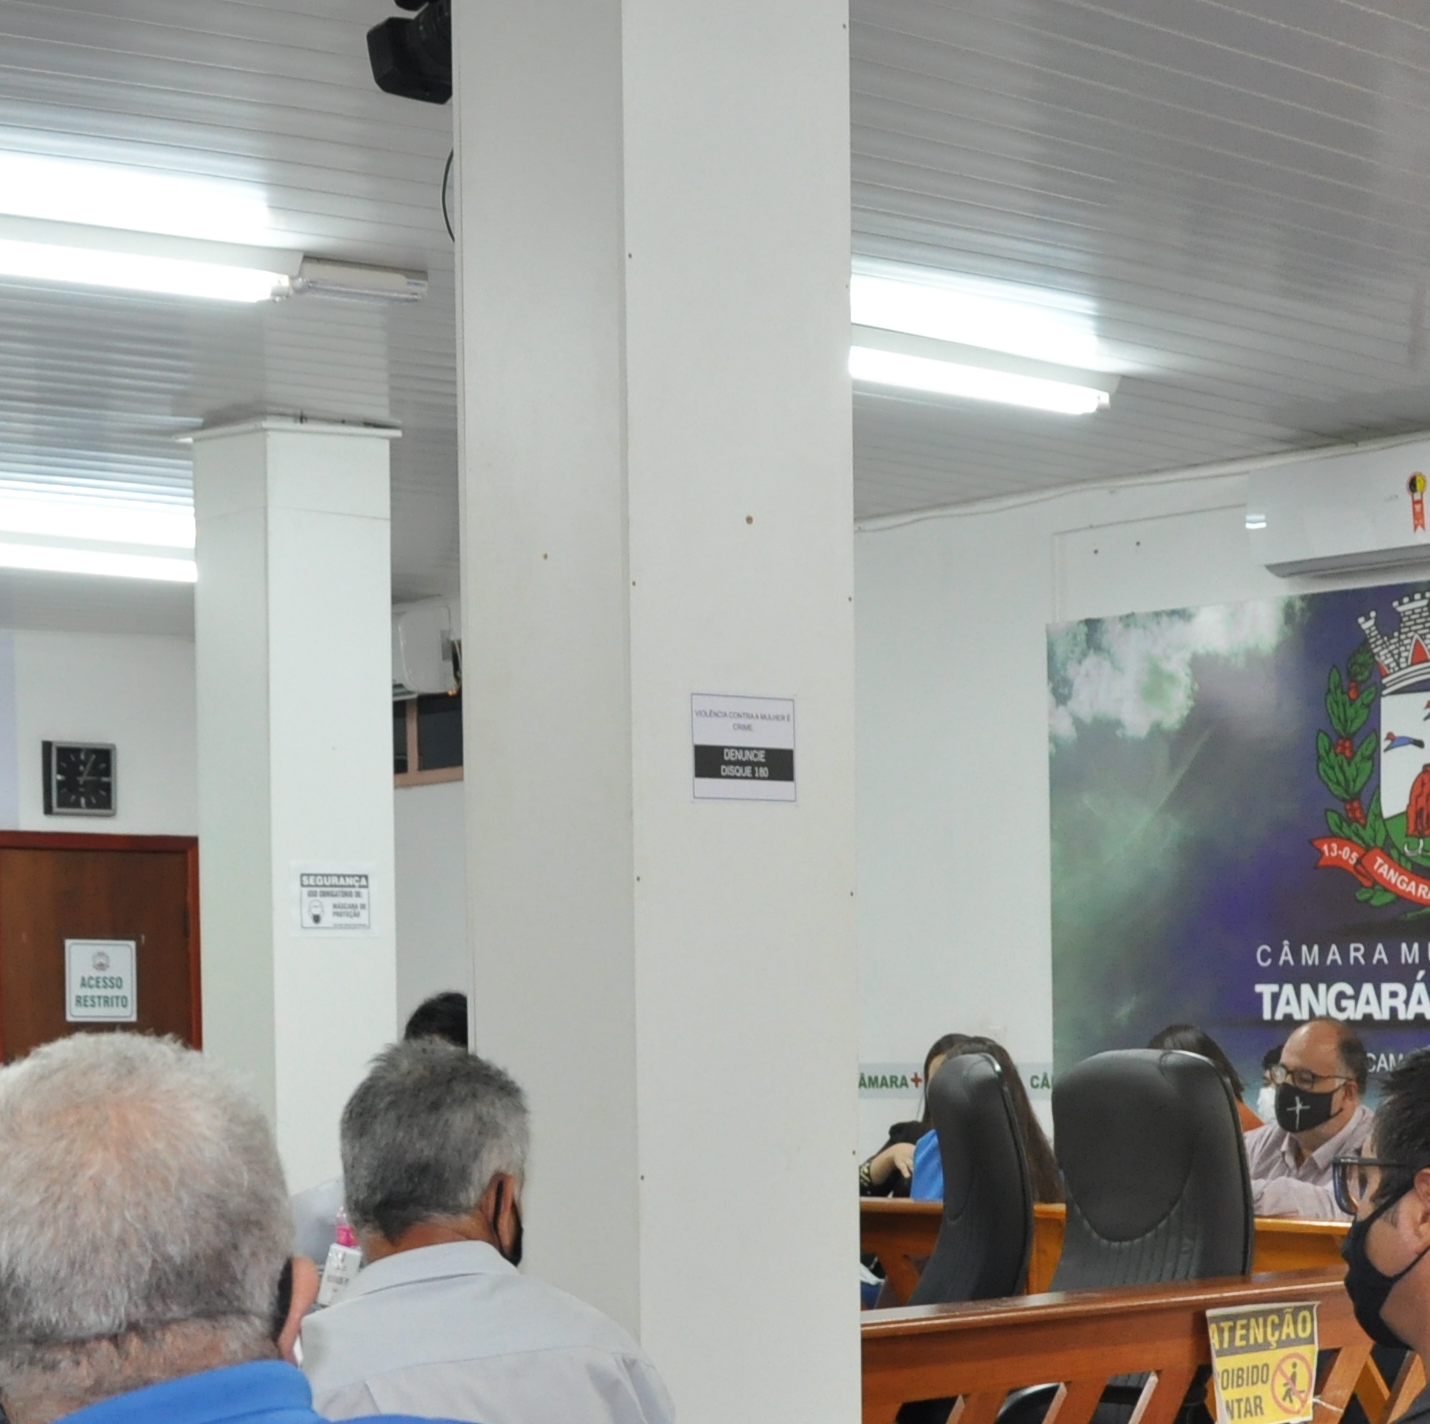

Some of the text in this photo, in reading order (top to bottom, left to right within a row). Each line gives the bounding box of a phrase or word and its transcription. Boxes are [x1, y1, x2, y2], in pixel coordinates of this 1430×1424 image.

[695, 709, 727, 718] VIOLÊNCIA
[723, 748, 766, 762] DENUNCIE
[720, 764, 769, 778] DISQUE 180
[1322, 843, 1357, 864] 13-05
[301, 875, 368, 888] SEGURANÇA
[1256, 940, 1389, 967] CÂMARA
[80, 975, 124, 990] ACESSO
[75, 994, 128, 1009] RESTRITO
[1210, 1307, 1312, 1350] ATENÇÃO
[1217, 1363, 1270, 1391] OIBIDO
